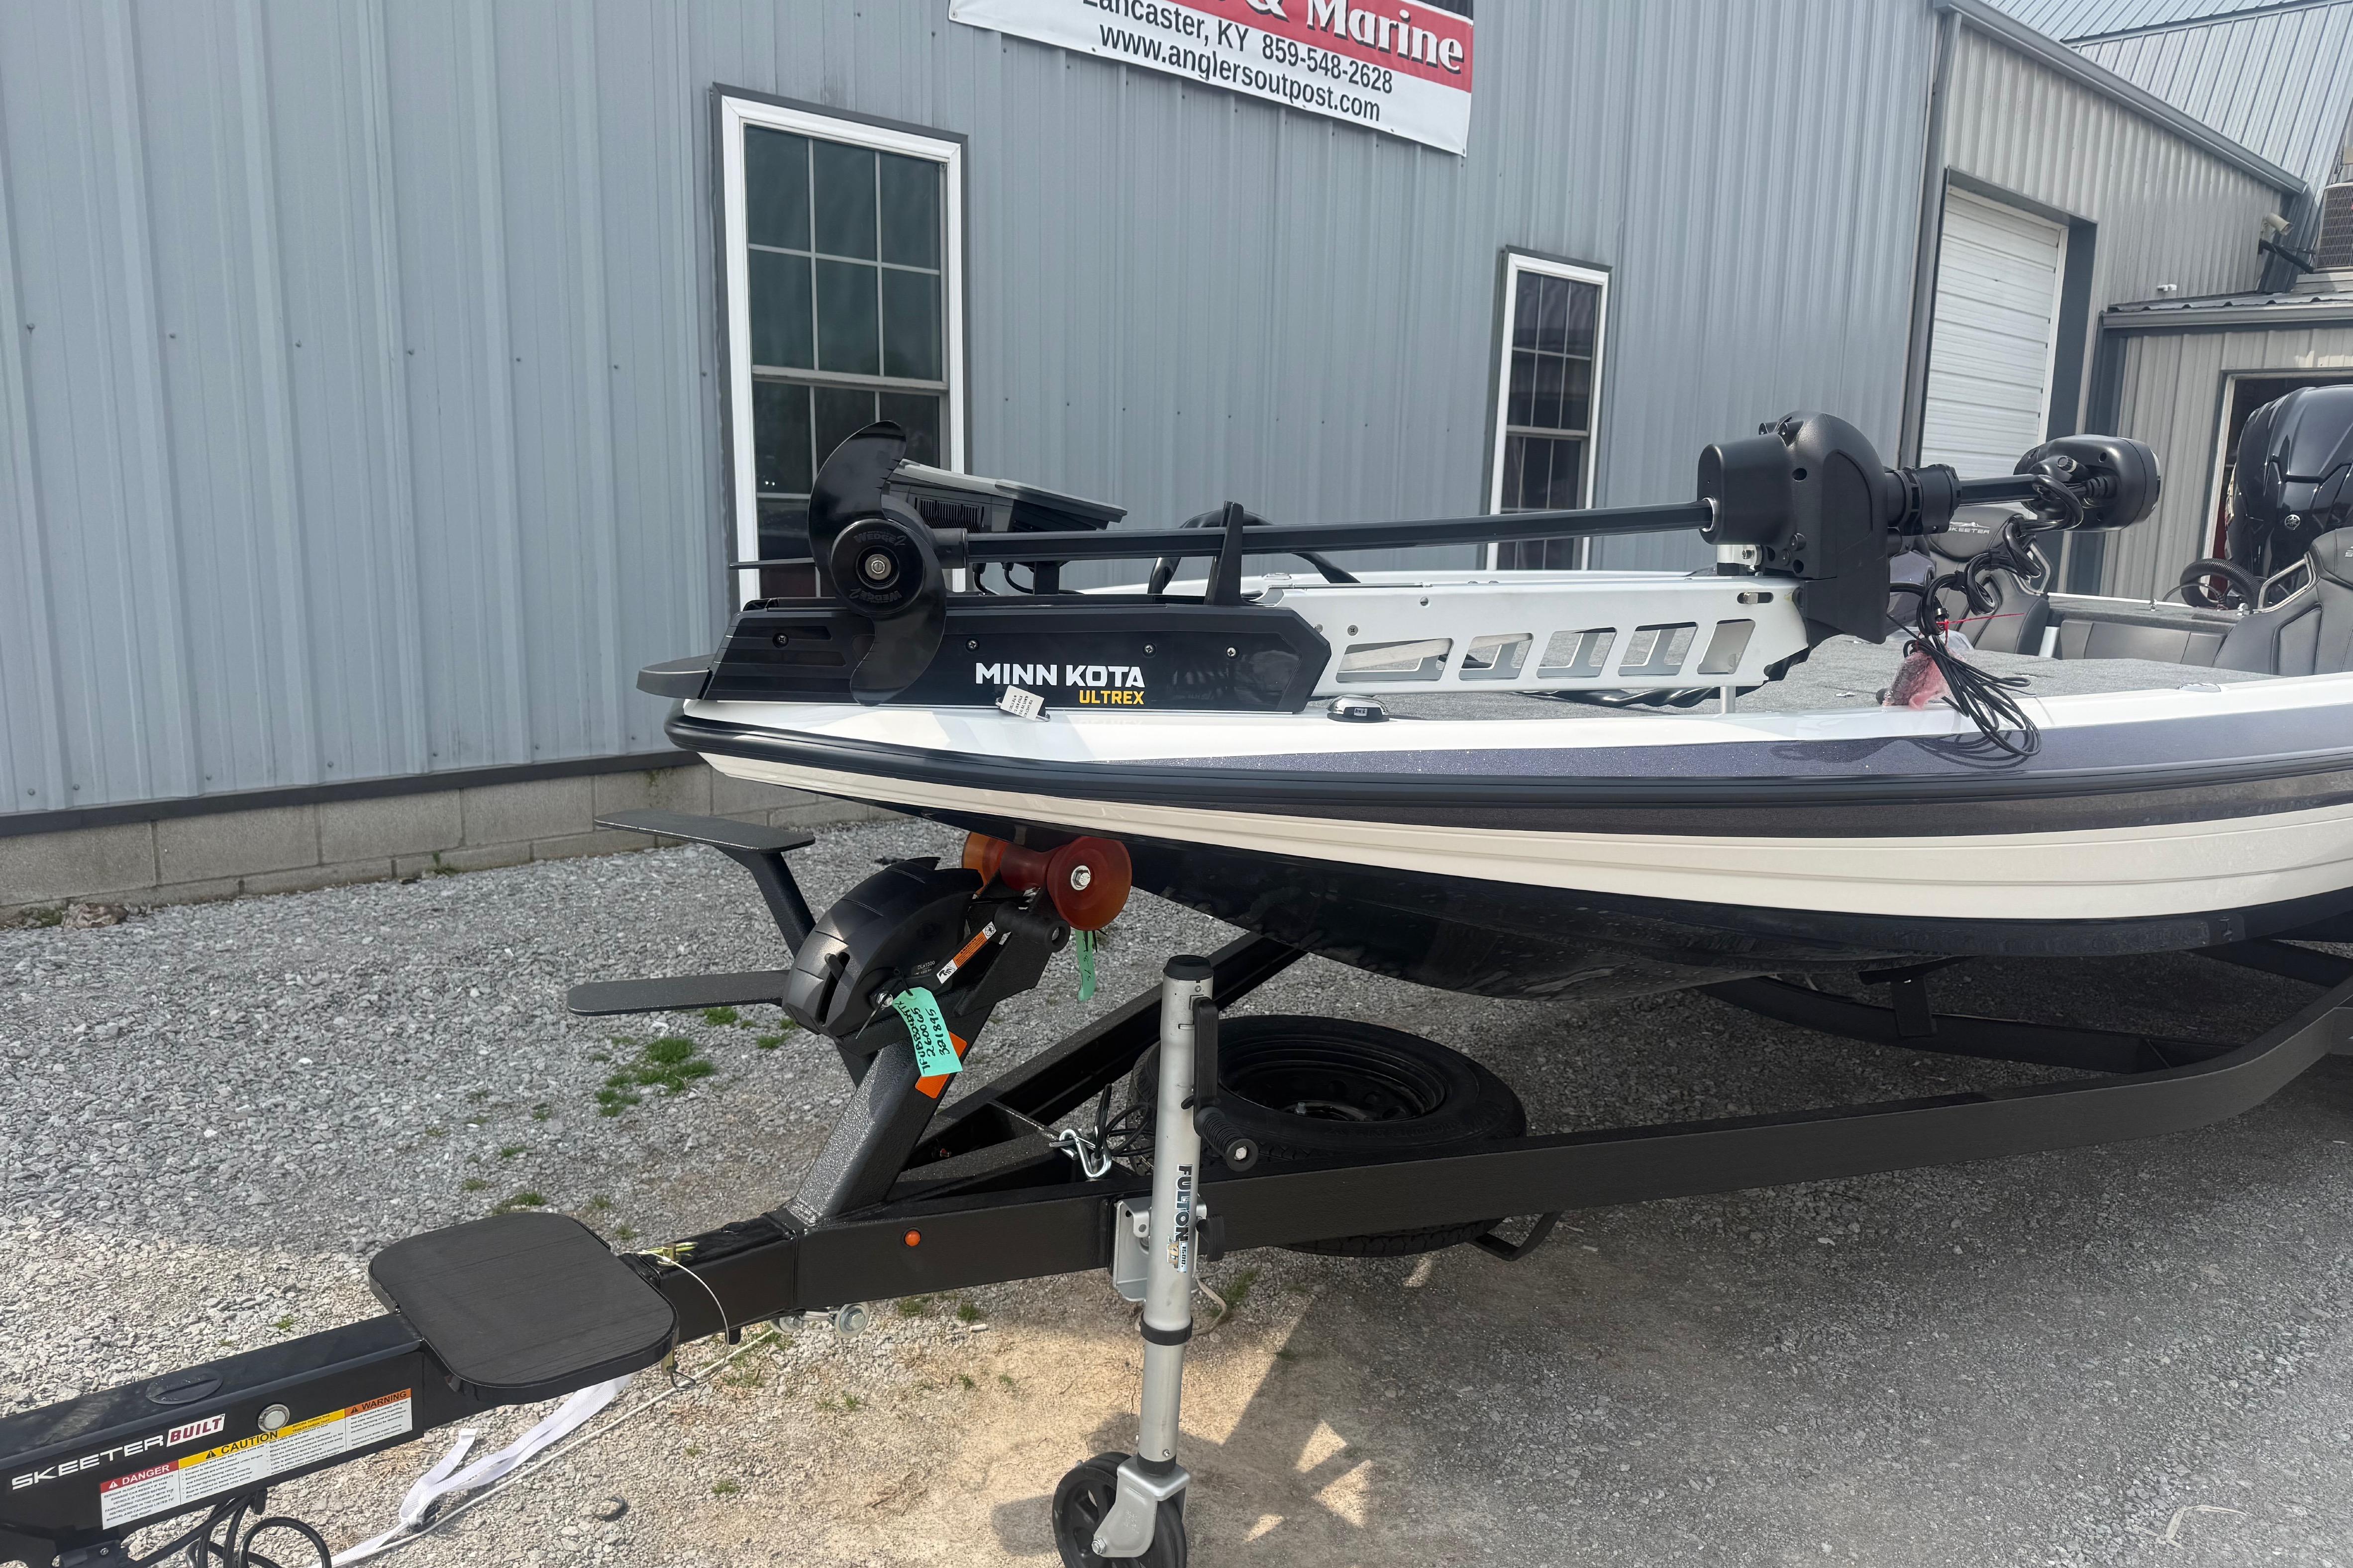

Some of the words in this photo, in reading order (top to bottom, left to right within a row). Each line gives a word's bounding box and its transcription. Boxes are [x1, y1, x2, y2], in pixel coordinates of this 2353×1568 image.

[1083, 0, 1209, 47] ancaster,
[1218, 19, 1249, 52] KY
[1262, 33, 1393, 94] 859-548-2628
[1307, 0, 1464, 74] Marine
[1100, 23, 1380, 122] www.anglersoutpost.com
[853, 532, 896, 544] WEDGE
[976, 662, 1058, 686] MINN
[1066, 664, 1145, 687] KOTA
[1079, 689, 1144, 705] ULTREX
[925, 1008, 950, 1056] 321895
[1174, 1164, 1194, 1243] FULTON
[362, 1391, 407, 1410] WARNING
[11, 1435, 164, 1490] SKEETER
[169, 1417, 222, 1444] BUILT
[221, 1430, 278, 1454] CAUTION
[122, 1465, 170, 1485] DANGER
